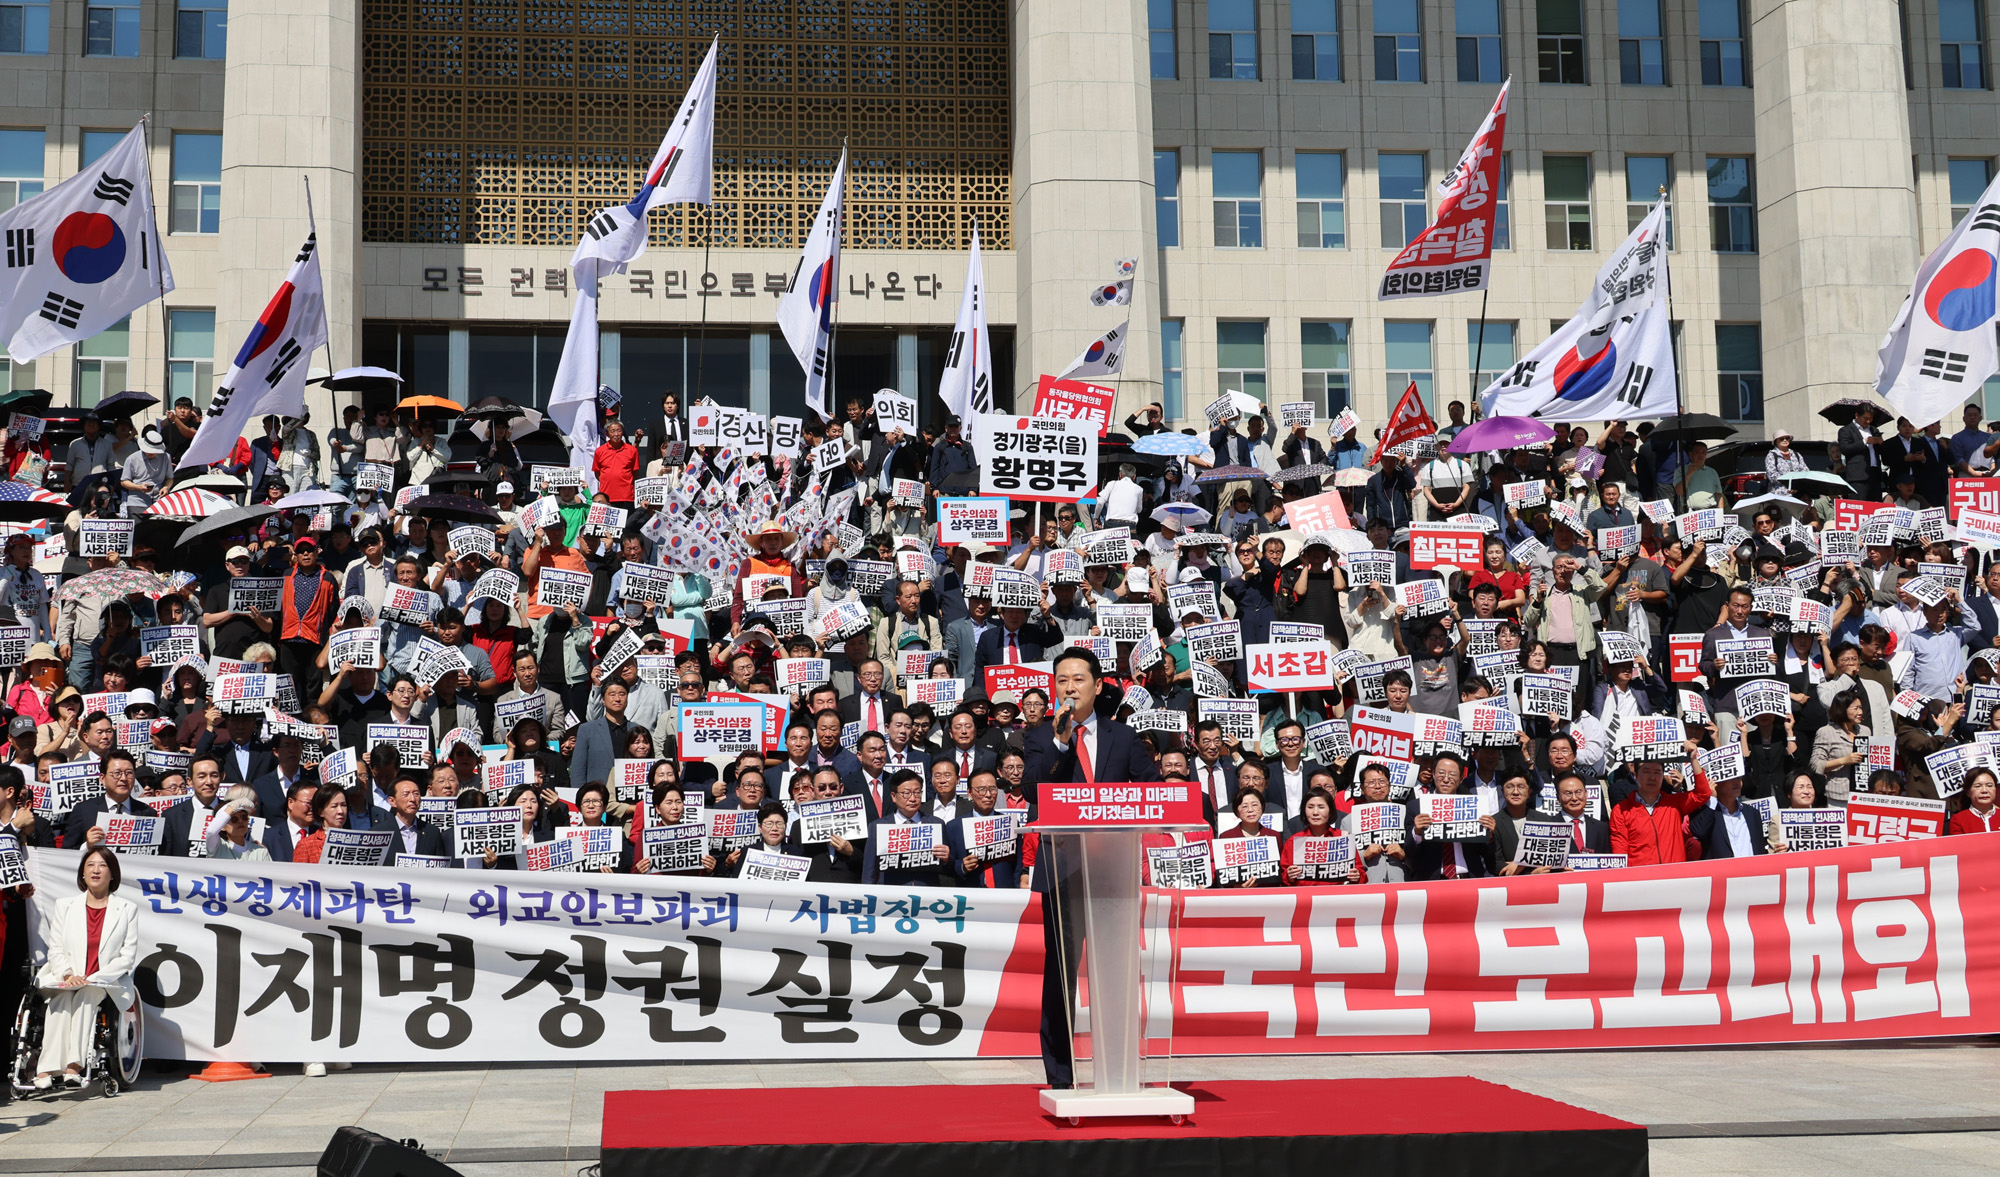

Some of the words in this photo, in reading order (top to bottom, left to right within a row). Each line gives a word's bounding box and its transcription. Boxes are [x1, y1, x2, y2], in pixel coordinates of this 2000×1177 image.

[422, 267, 484, 296] 모든
[510, 267, 602, 298] 권력
[630, 269, 788, 300] 국민으로부
[849, 274, 942, 301] 나온다
[878, 399, 915, 427] 의회
[1283, 411, 1311, 419] 대통령은
[742, 421, 765, 445] 산
[1032, 420, 1066, 431] 국민의힘
[776, 423, 799, 447] 당
[993, 431, 1087, 456] 경기광주(을)
[360, 472, 392, 482] 대통령은
[991, 456, 1087, 491] 황명주
[950, 509, 998, 519] 보수의심장
[82, 521, 134, 531] 정책실패·인사참사
[950, 519, 998, 530] 상주문경
[85, 532, 128, 543] 대통령은
[452, 536, 492, 551] 대통령은
[85, 544, 128, 555] 사죄하라
[1413, 536, 1480, 563] 칠곡군
[1087, 550, 1128, 565] 사죄하라
[1349, 553, 1394, 563] 정책실패·인사참사
[626, 562, 674, 581] 정책실패·인사참사
[1352, 562, 1392, 573] 대통령은
[232, 578, 284, 589] 정책실패·인사참사
[626, 576, 668, 592] 대통령은
[1352, 573, 1391, 585] 사죄하라
[542, 580, 586, 598] 대통령은
[1404, 580, 1438, 594] 민생파탄
[234, 590, 278, 601] 대통령은
[624, 588, 666, 605] 사죄하라
[1405, 589, 1441, 605] 헌정파괴
[757, 601, 806, 611] 정책실패·인사참사
[1101, 615, 1147, 629] 대통령은
[1102, 627, 1148, 641] 사죄하라
[1187, 623, 1239, 638] 정책실패·인사참사
[1272, 623, 1323, 638] 정책실패·인사참사
[149, 639, 195, 652] 대통령은
[1191, 634, 1235, 651] 대통령은
[1718, 640, 1771, 651] 정책실패·인사참사
[332, 642, 374, 659] 대통령은
[1724, 651, 1768, 662] 대통령은
[787, 659, 824, 672] 민생파탄
[1251, 651, 1328, 678] 서초갑
[1724, 663, 1770, 675] 사죄하라
[223, 675, 266, 688] 민생파탄
[787, 670, 823, 683] 헌정파괴
[997, 675, 1049, 689] 보수의심장
[221, 687, 265, 699] 헌정파괴
[917, 680, 957, 693] 민생파탄
[916, 691, 956, 703] 헌정파괴
[1527, 688, 1568, 705] 대통령은
[1741, 691, 1785, 708] 대통령은
[497, 696, 546, 713] 정책실패·인사참사
[1200, 701, 1257, 713] 정책실패·인사참사
[1743, 702, 1787, 721] 사죄하라
[1368, 713, 1391, 722] 국민의힘
[1473, 707, 1515, 722] 민생파탄
[693, 717, 752, 728] 보수의심장
[1472, 718, 1516, 732] 헌정파괴
[1632, 719, 1678, 732] 민생파탄
[369, 727, 427, 739] 정책실패·인사참사
[693, 729, 752, 743] 상주문경
[1463, 732, 1482, 747] 강력
[1632, 730, 1678, 744] 헌정파괴
[719, 744, 758, 752] 당원협의회
[1624, 745, 1645, 760] 강력
[487, 761, 525, 774] 민생파탄
[488, 772, 525, 790] 헌정파괴
[1052, 788, 1095, 803] 국민의
[1099, 787, 1142, 803] 일상과
[1145, 786, 1188, 803] 미래를
[800, 796, 862, 818] 정책실패·인사참사
[1431, 796, 1478, 811] 민생파탄
[456, 809, 521, 824] 정책실패·인사참사
[714, 811, 757, 824] 민생파탄
[1078, 804, 1165, 821] 지키겠습니다
[1360, 805, 1401, 820] 민생파탄
[1431, 809, 1478, 823] 헌정파괴
[1781, 811, 1844, 824] 정책실패·인사참사
[108, 818, 156, 833] 민생파탄
[460, 824, 516, 840] 대통령은
[712, 824, 757, 836] 헌정파괴
[974, 815, 1013, 834] 민생파탄
[1360, 818, 1400, 832] 헌정파괴
[1523, 824, 1572, 837] 정책실패·인사참사
[1786, 825, 1842, 839] 대통령은
[104, 831, 153, 846] 헌정파괴
[328, 830, 391, 846] 정책실패·인사참사
[645, 825, 706, 842] 정책실패·인사참사
[888, 826, 934, 841] 민생파탄
[975, 827, 1011, 846] 헌정파괴
[1424, 825, 1444, 840] 강력
[461, 839, 517, 856] 사죄하라
[526, 839, 572, 861] 민생파탄
[650, 840, 702, 857] 대통령은
[887, 839, 933, 852] 헌정파괴
[1224, 838, 1269, 853] 민생파탄
[1305, 837, 1349, 853] 민생파탄
[1524, 838, 1566, 852] 대통령은
[327, 845, 383, 861] 대통령은
[527, 850, 573, 871] 헌정파괴
[1225, 851, 1269, 866] 헌정파괴
[1304, 850, 1349, 864] 헌정파괴
[1519, 852, 1565, 866] 사죄하라
[748, 854, 809, 871] 정책실패·인사참사
[879, 855, 899, 871] 강력
[1568, 857, 1627, 869] 정책실패·인사참사
[749, 865, 800, 880] 대통령은
[1218, 868, 1239, 885] 강력
[1241, 861, 1279, 883] 규탄한다
[138, 871, 420, 925] 민생경제파탄
[470, 883, 739, 932] 외교안보파괴
[789, 893, 975, 936] 사법장악
[1473, 854, 1971, 1032] 보고대회
[133, 923, 476, 1050] 이재명
[502, 934, 726, 1049] 정권
[747, 938, 969, 1047] 실정
